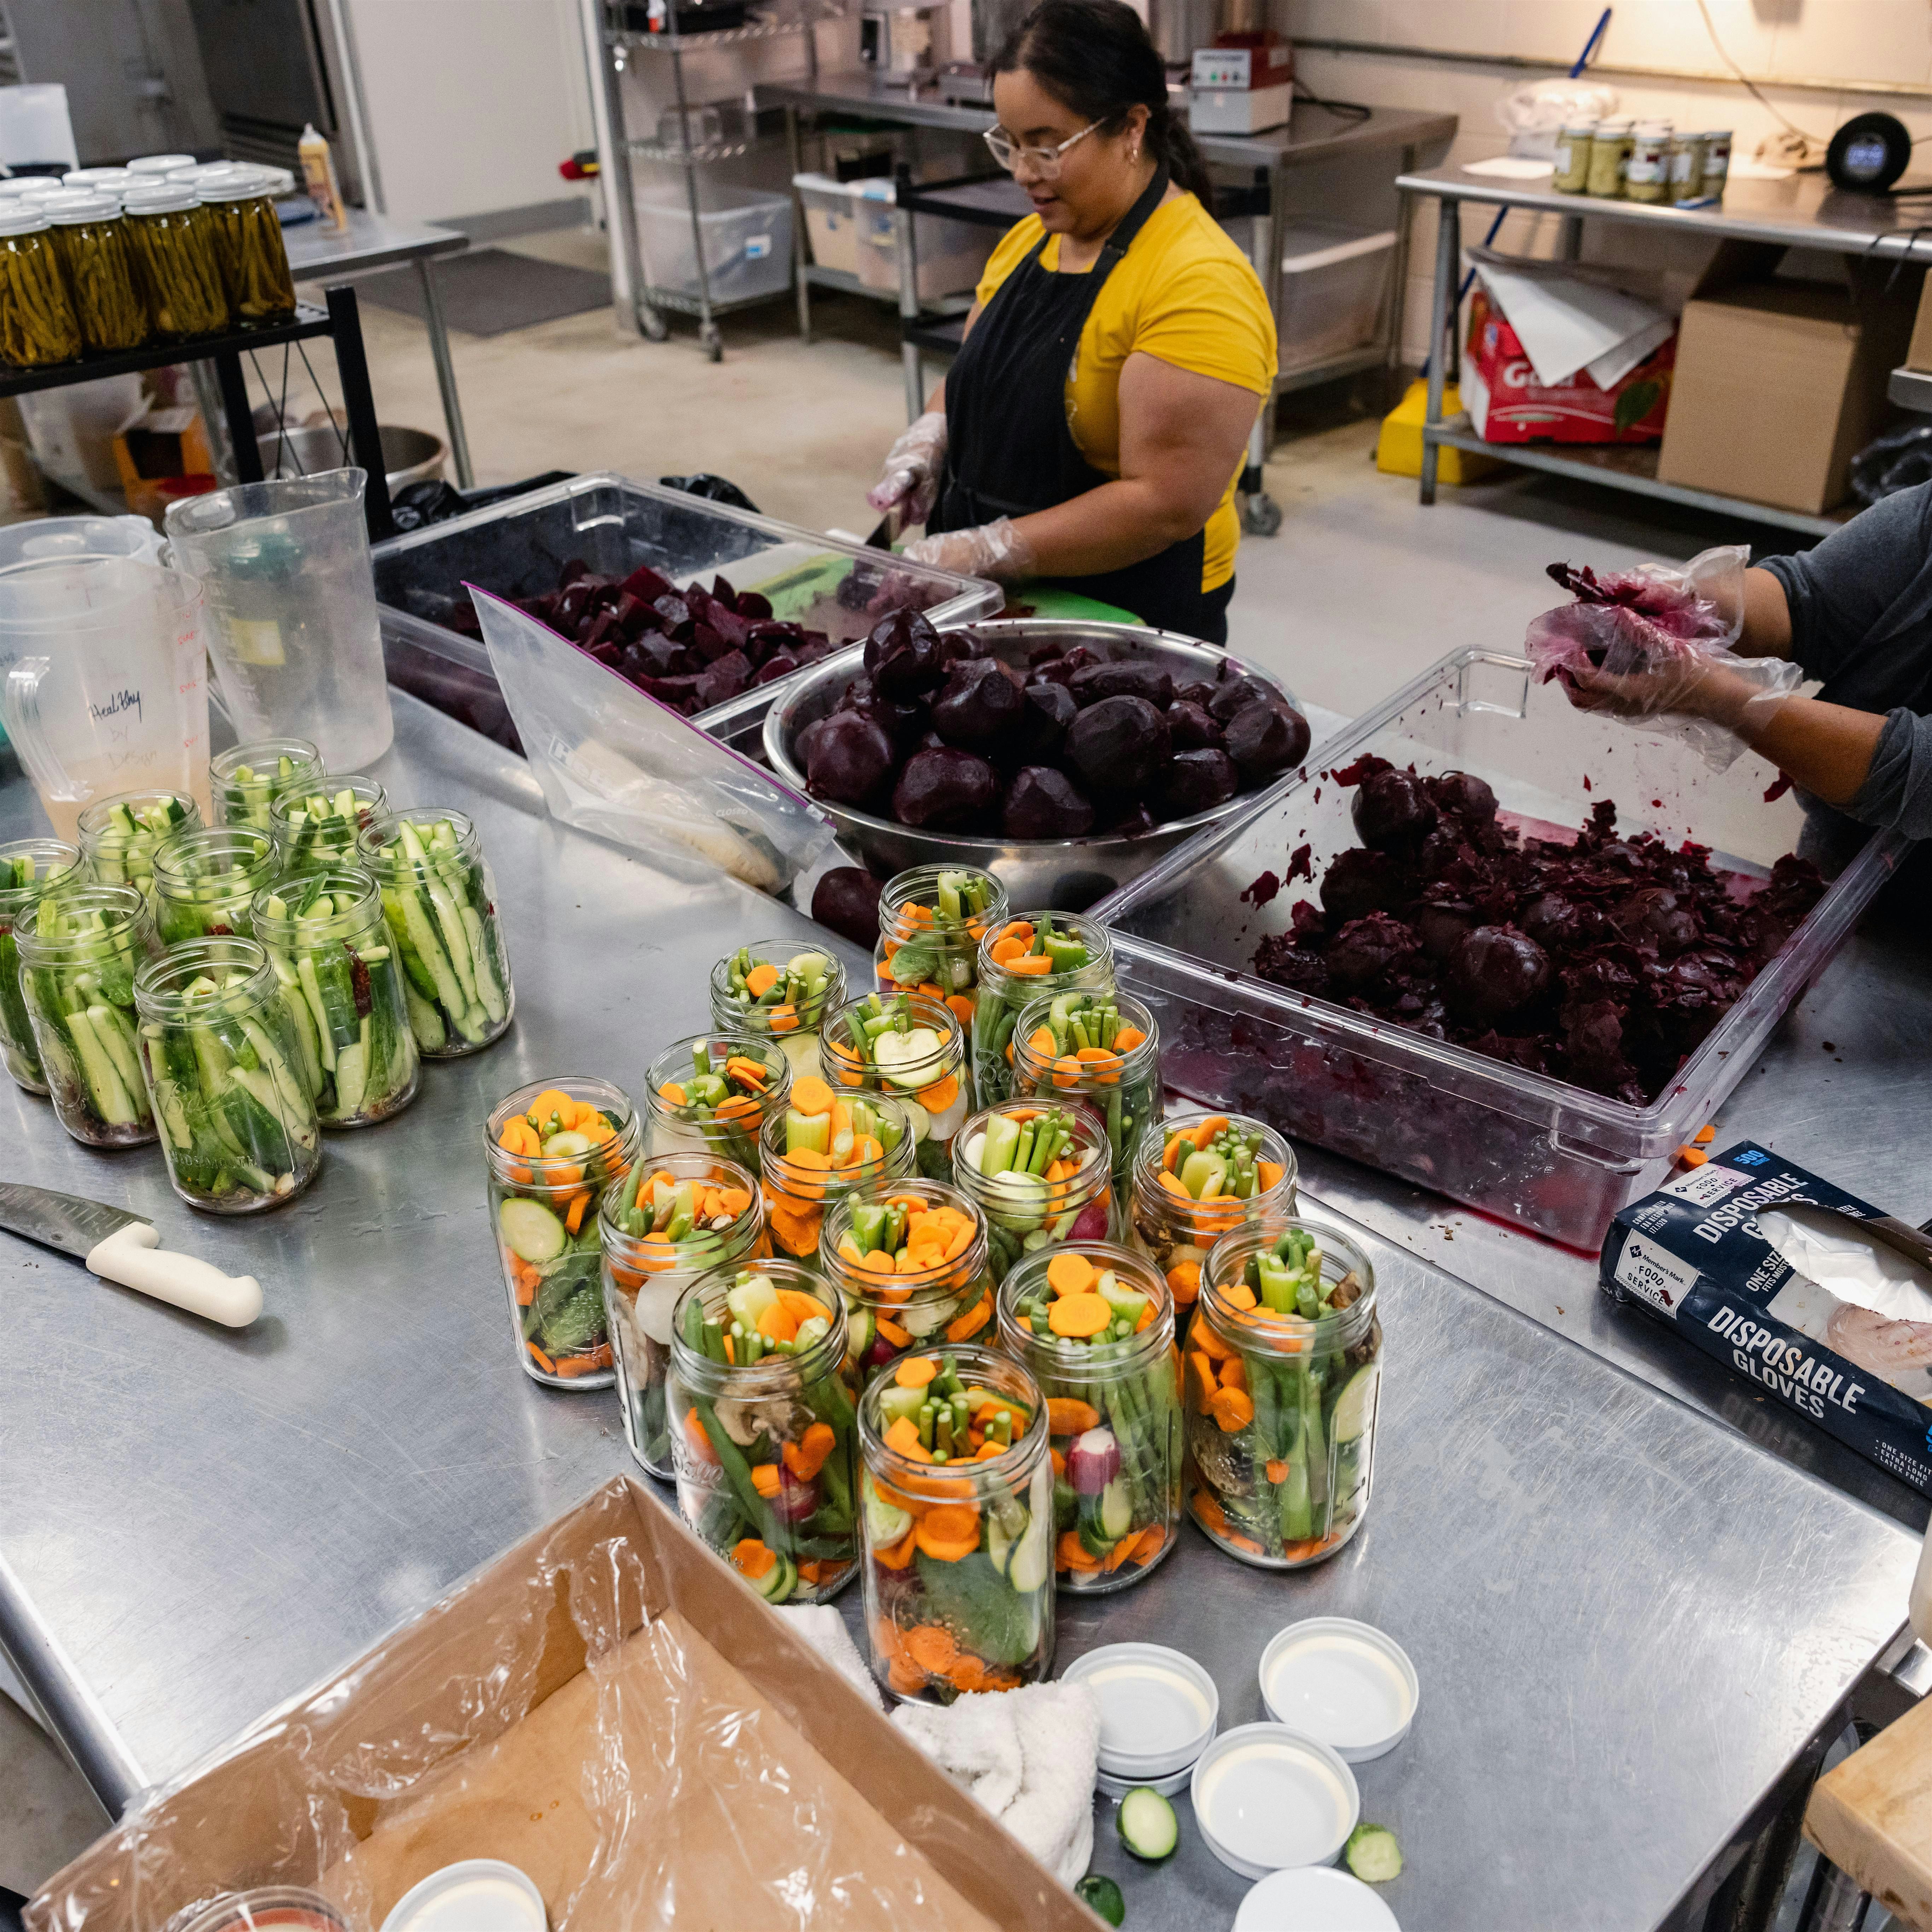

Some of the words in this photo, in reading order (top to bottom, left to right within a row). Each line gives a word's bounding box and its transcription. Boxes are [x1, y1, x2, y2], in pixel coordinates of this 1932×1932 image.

[1733, 1150, 1765, 1164] 500
[1696, 1178, 1718, 1190] FOOD
[1703, 1178, 1738, 1198] SERVICE
[1705, 1169, 1717, 1177] Mark
[1632, 1207, 1655, 1224] COMPLIES
[1693, 1172, 1809, 1244] DISPOSABLE
[1648, 1218, 1668, 1234] 177.1520
[1639, 1265, 1664, 1286] FOOD
[1642, 1255, 1669, 1274] Member's
[1669, 1271, 1684, 1284] Mark
[1746, 1267, 1770, 1292] ONE
[1763, 1251, 1783, 1270] SIZ
[1762, 1276, 1776, 1292] FITS
[1772, 1260, 1790, 1280] MOST
[1628, 1273, 1664, 1305] SERVICE
[1707, 1305, 1865, 1414] DISPOSABLE
[1733, 1349, 1824, 1419] GLOVES
[1880, 1456, 1903, 1473] LATEX
[1905, 1471, 1924, 1486] FREE
[1881, 1449, 1904, 1467] EXTRA
[1908, 1465, 1927, 1481] LONG
[1882, 1442, 1897, 1455] ONE
[1899, 1453, 1917, 1467] SIZE
[1919, 1464, 1932, 1475] FIT
